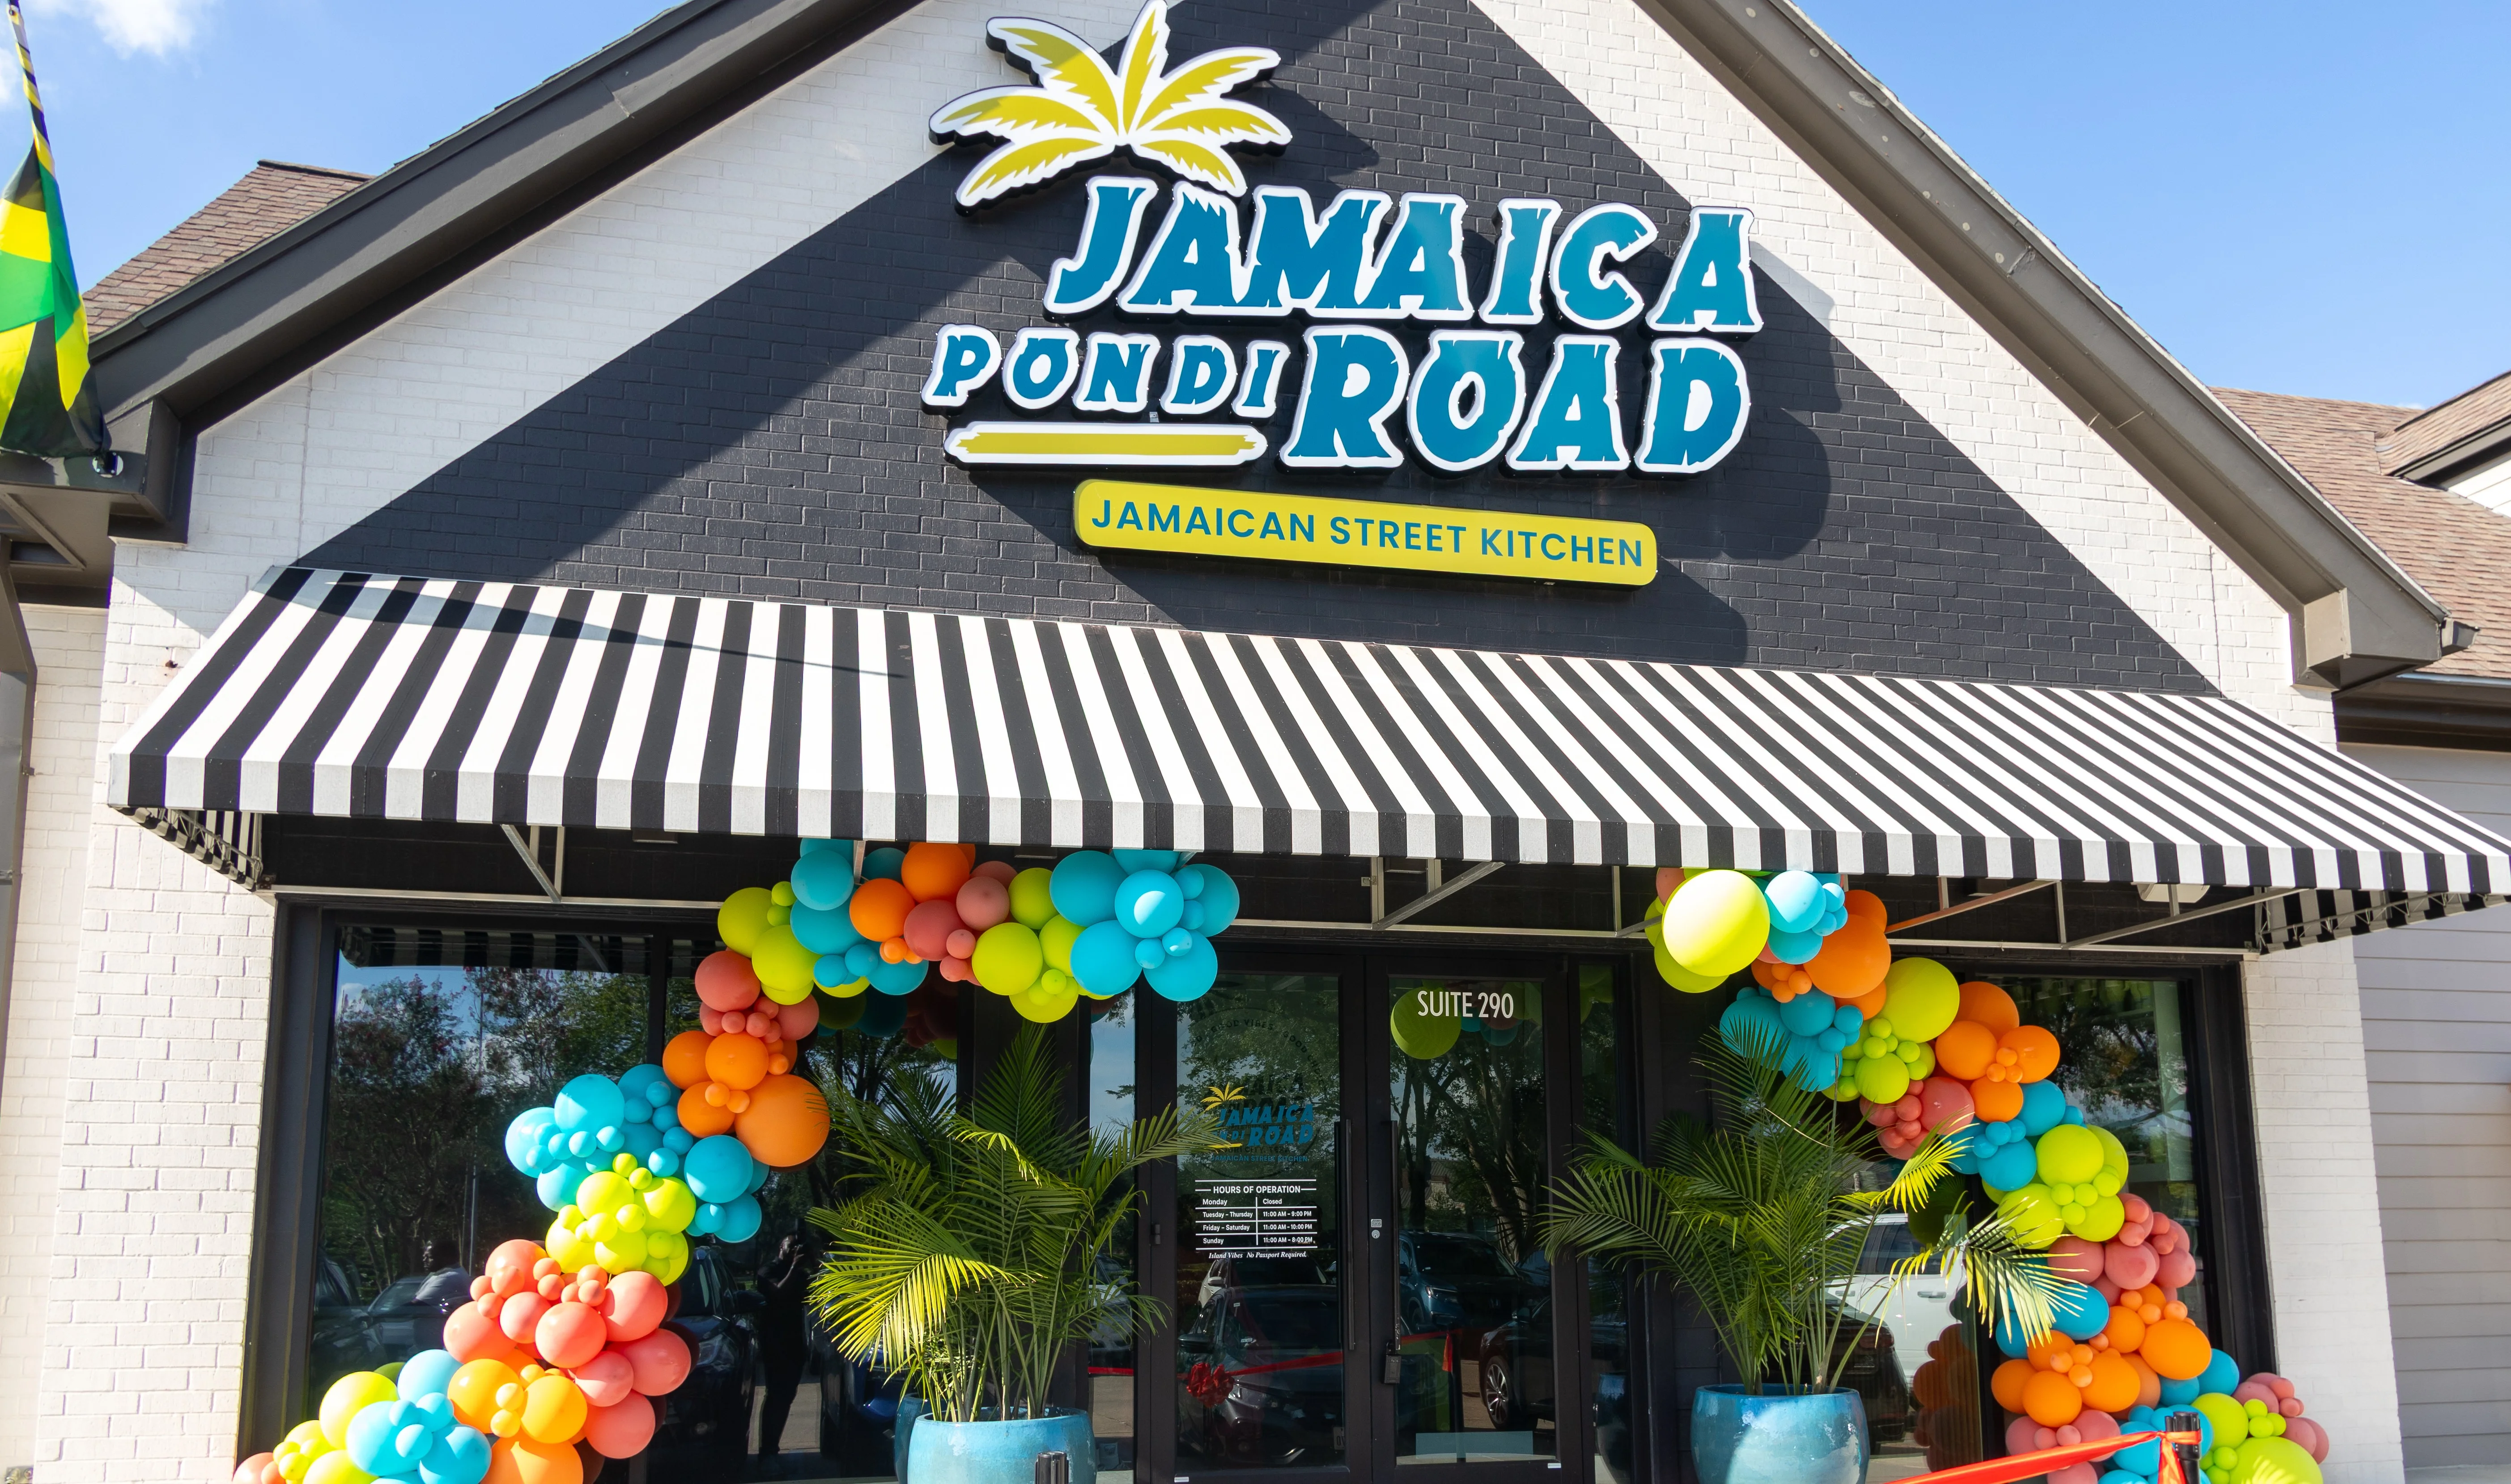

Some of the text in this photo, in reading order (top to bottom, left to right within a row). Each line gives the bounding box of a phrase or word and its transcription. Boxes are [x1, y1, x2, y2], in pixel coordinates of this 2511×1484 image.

[1051, 182, 1758, 328] JAMAICA
[1285, 331, 1746, 469] ROAD
[1092, 499, 1642, 567] JAMAICAN STREET KITCHEN
[1417, 990, 1514, 1018] SUITE 290
[1215, 1103, 1314, 1127] JAMAICA
[1247, 1124, 1314, 1147] ROAD
[1213, 1186, 1241, 1194] HOURS
[1256, 1185, 1300, 1193] OPERATION
